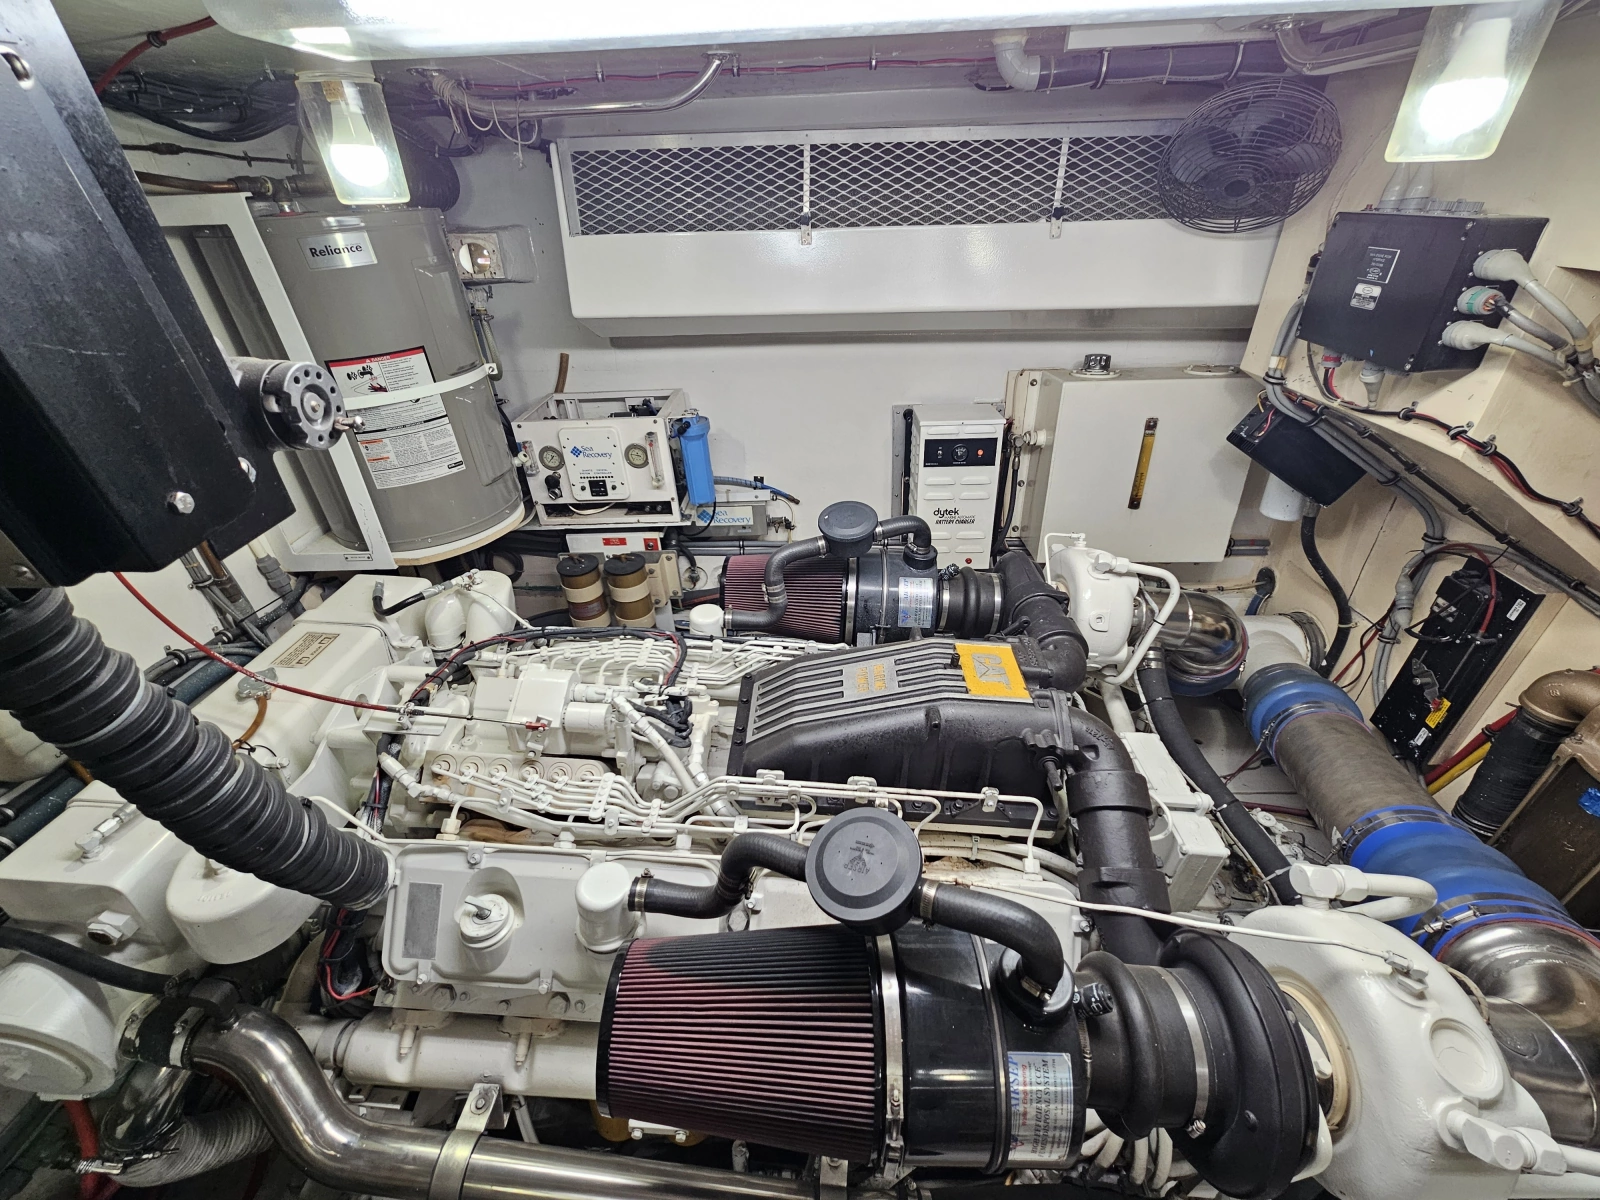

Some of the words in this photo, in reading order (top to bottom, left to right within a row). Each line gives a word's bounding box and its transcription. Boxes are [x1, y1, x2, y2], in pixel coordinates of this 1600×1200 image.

[309, 244, 363, 258] Reliance
[583, 452, 613, 460] Recovery
[714, 517, 751, 525] Recovery
[933, 508, 959, 518] dytek
[971, 653, 1013, 690] CAT
[1042, 1059, 1050, 1096] SYSTEM
[1035, 1088, 1043, 1137] EFFICIENCY
[1042, 1098, 1051, 1136] DISPOSAL
